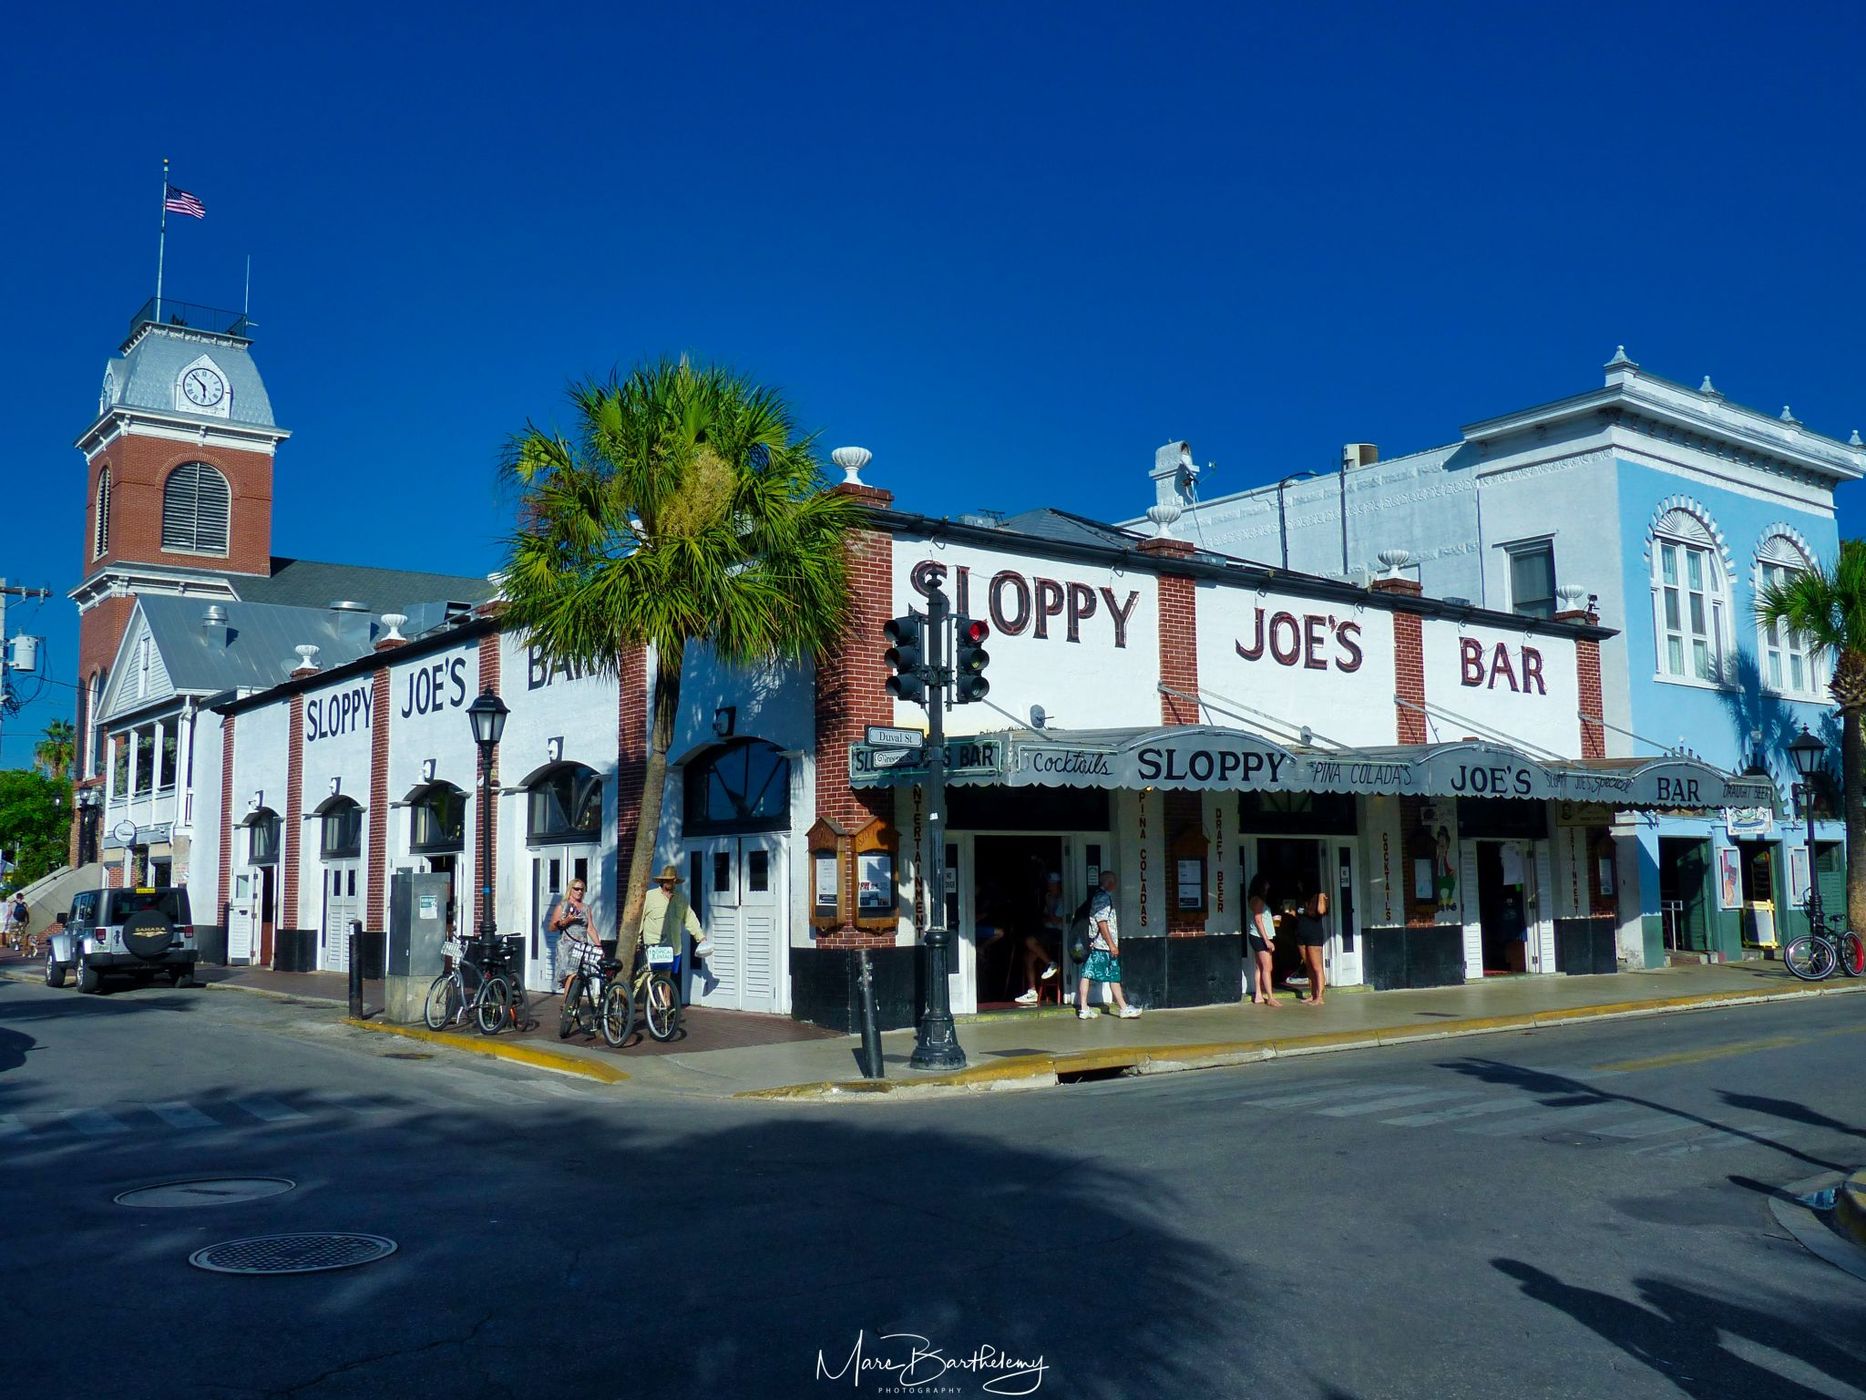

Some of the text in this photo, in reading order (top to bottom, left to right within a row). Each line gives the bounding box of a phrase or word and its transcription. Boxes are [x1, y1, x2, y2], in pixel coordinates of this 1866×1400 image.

[1235, 607, 1364, 674] JOE'S
[1459, 636, 1548, 696] BAR
[306, 682, 375, 742] SLOPPY
[401, 656, 467, 719] JOE'S
[879, 731, 913, 744] Duval St
[959, 744, 995, 768] BAR
[1033, 750, 1114, 776] Cocktails
[1137, 748, 1288, 783] SLOPPY
[1450, 765, 1532, 795] JOE'S
[1656, 777, 1700, 802] BAR
[912, 786, 924, 939] NTERTAINMENT
[1139, 849, 1148, 927] COLADAS
[1215, 808, 1224, 913] DRAFT BEER
[1382, 832, 1391, 921] COCKTAILS
